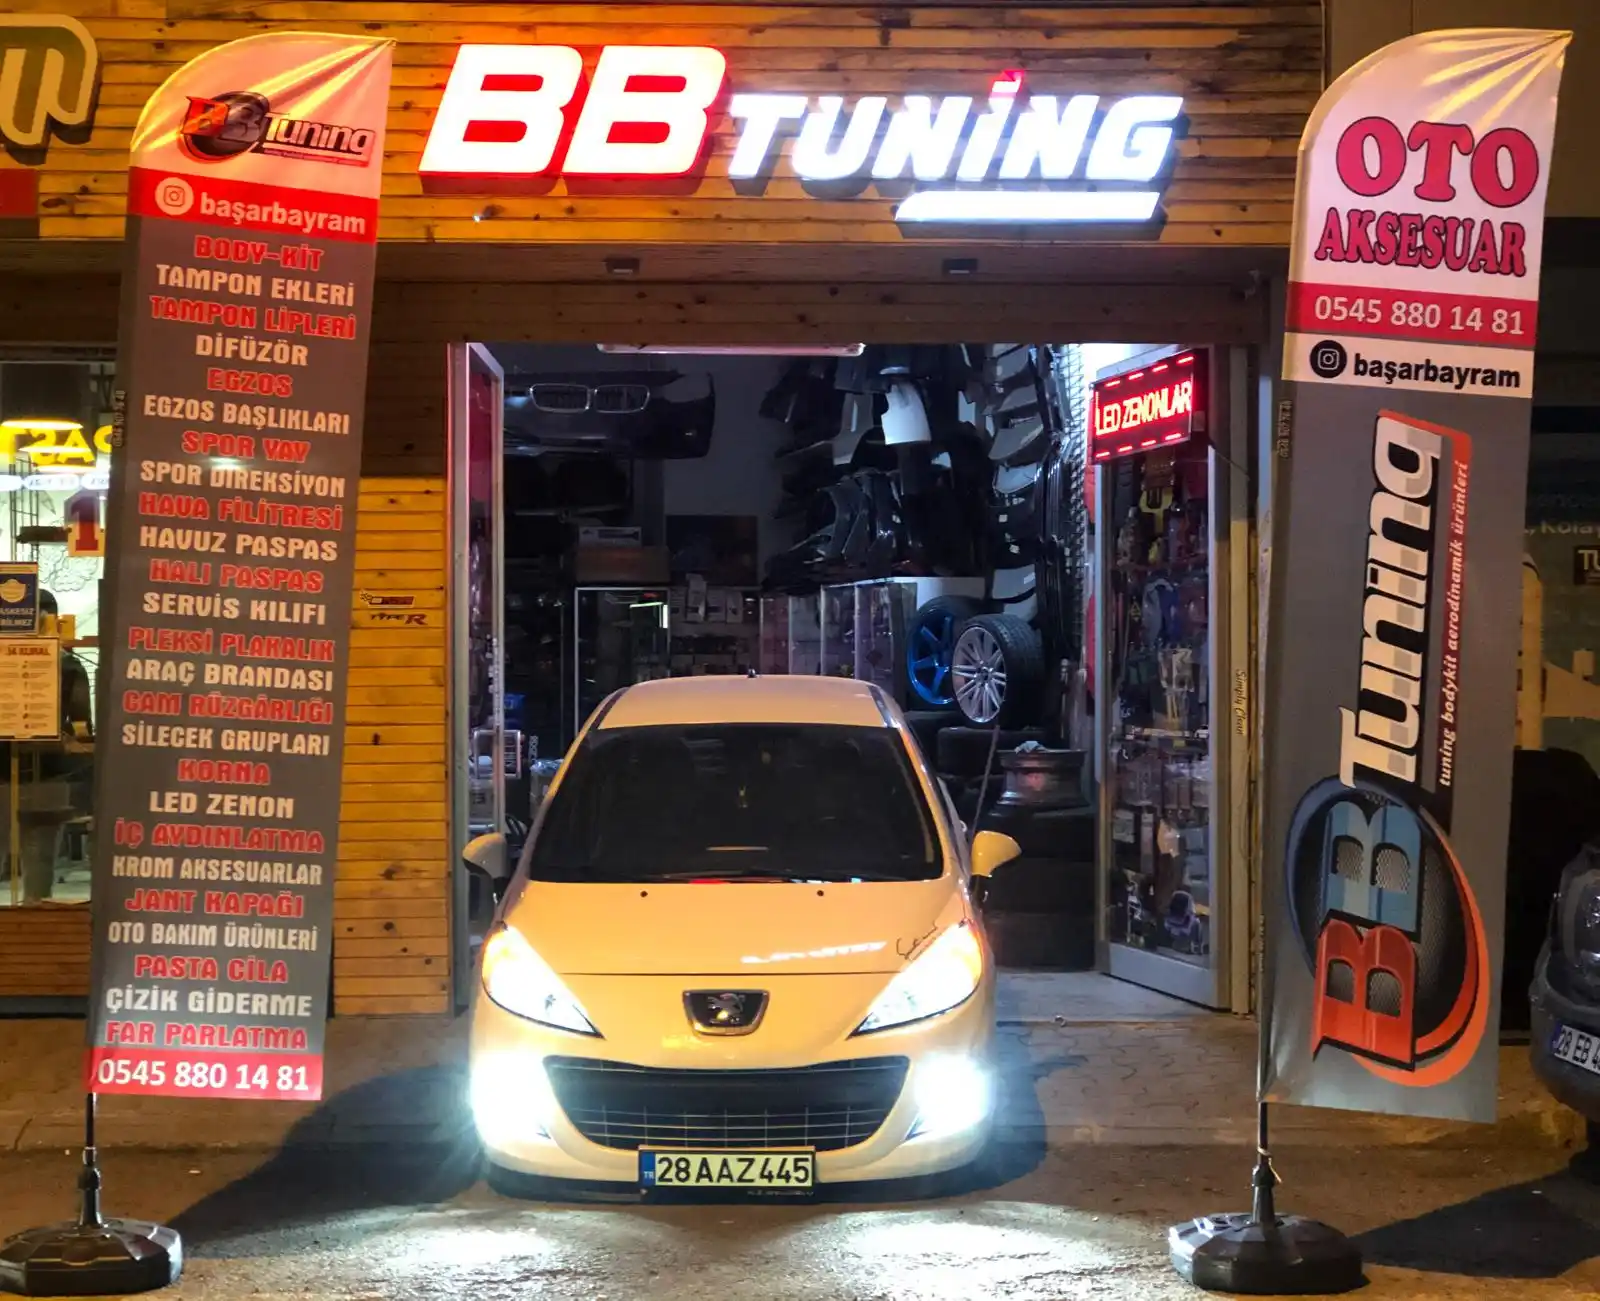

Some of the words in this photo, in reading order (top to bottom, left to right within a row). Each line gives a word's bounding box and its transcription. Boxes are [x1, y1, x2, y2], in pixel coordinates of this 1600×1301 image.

[417, 44, 727, 180] BB
[263, 112, 376, 160] Tuning
[1336, 116, 1539, 208] OTO
[200, 192, 366, 234] başarbayram
[194, 235, 324, 271] BODY-KİT
[1314, 207, 1526, 277] AKSESUAR
[156, 264, 262, 296] TAMPON
[271, 277, 355, 307] EKLERİ
[149, 296, 256, 328] TAMPON
[264, 306, 356, 340] LİPLERİ
[1314, 295, 1382, 323] 0545
[1390, 301, 1442, 328] 880
[1450, 306, 1482, 331] 14
[1491, 309, 1524, 334] 81
[195, 333, 309, 366] DİFÜZÖR
[207, 368, 293, 397] EGZOS
[1353, 353, 1520, 390] başarbayram
[143, 395, 215, 422] EGZOS
[223, 402, 351, 435] BAŞLIKLARI
[1095, 398, 1121, 436] LED
[1121, 380, 1192, 429] ZENONLAR
[181, 430, 255, 458] SPOR
[263, 439, 312, 463] YAY
[140, 460, 201, 486] SPOR
[138, 491, 210, 519] HAVA
[218, 496, 343, 531] FİLİTRESİ
[1451, 460, 1469, 535] ürünleri
[139, 526, 226, 553] HAVUZ
[235, 534, 338, 562] PASPAS
[150, 558, 211, 585] HALI
[220, 564, 324, 594] PASPAS
[142, 591, 240, 619] SERVİS
[249, 600, 326, 625] KILIFI
[1339, 414, 1443, 788] Tuning
[1447, 540, 1464, 650] aerodinamik
[128, 626, 213, 654] PLEKSİ
[220, 632, 335, 663] PLAKALIK
[126, 658, 195, 686] ARAÇ
[203, 663, 333, 691] BRANDASI
[1440, 653, 1459, 724] bodykit
[122, 690, 182, 716] CAM
[121, 720, 213, 749] SİLECEK
[220, 728, 330, 756] GRUPLARI
[177, 758, 271, 785] KORNA
[1439, 727, 1457, 787] tuning
[149, 790, 198, 814] LED
[205, 793, 294, 819] ZENON
[114, 817, 144, 849] İÇ
[152, 822, 324, 853] AYDINLATMA
[112, 855, 174, 879] KROM
[179, 858, 323, 885] AKSESUARLAR
[124, 888, 198, 913] JANT
[204, 890, 304, 918] KAPAĞI
[107, 921, 144, 944] OTO
[151, 922, 217, 947] BAKIM
[223, 921, 319, 952] ÜRÜNLERİ
[1313, 801, 1422, 1072] BB
[134, 956, 218, 980] PASTA
[227, 957, 288, 983] CİLA
[106, 985, 178, 1014] ÇİZİK
[188, 987, 312, 1017] GİDERME
[105, 1020, 156, 1044] FAR
[164, 1023, 308, 1050] PARLATMA
[98, 1059, 166, 1085] 0545
[174, 1061, 227, 1088] 880
[235, 1064, 269, 1090] 14
[276, 1065, 309, 1091] 81
